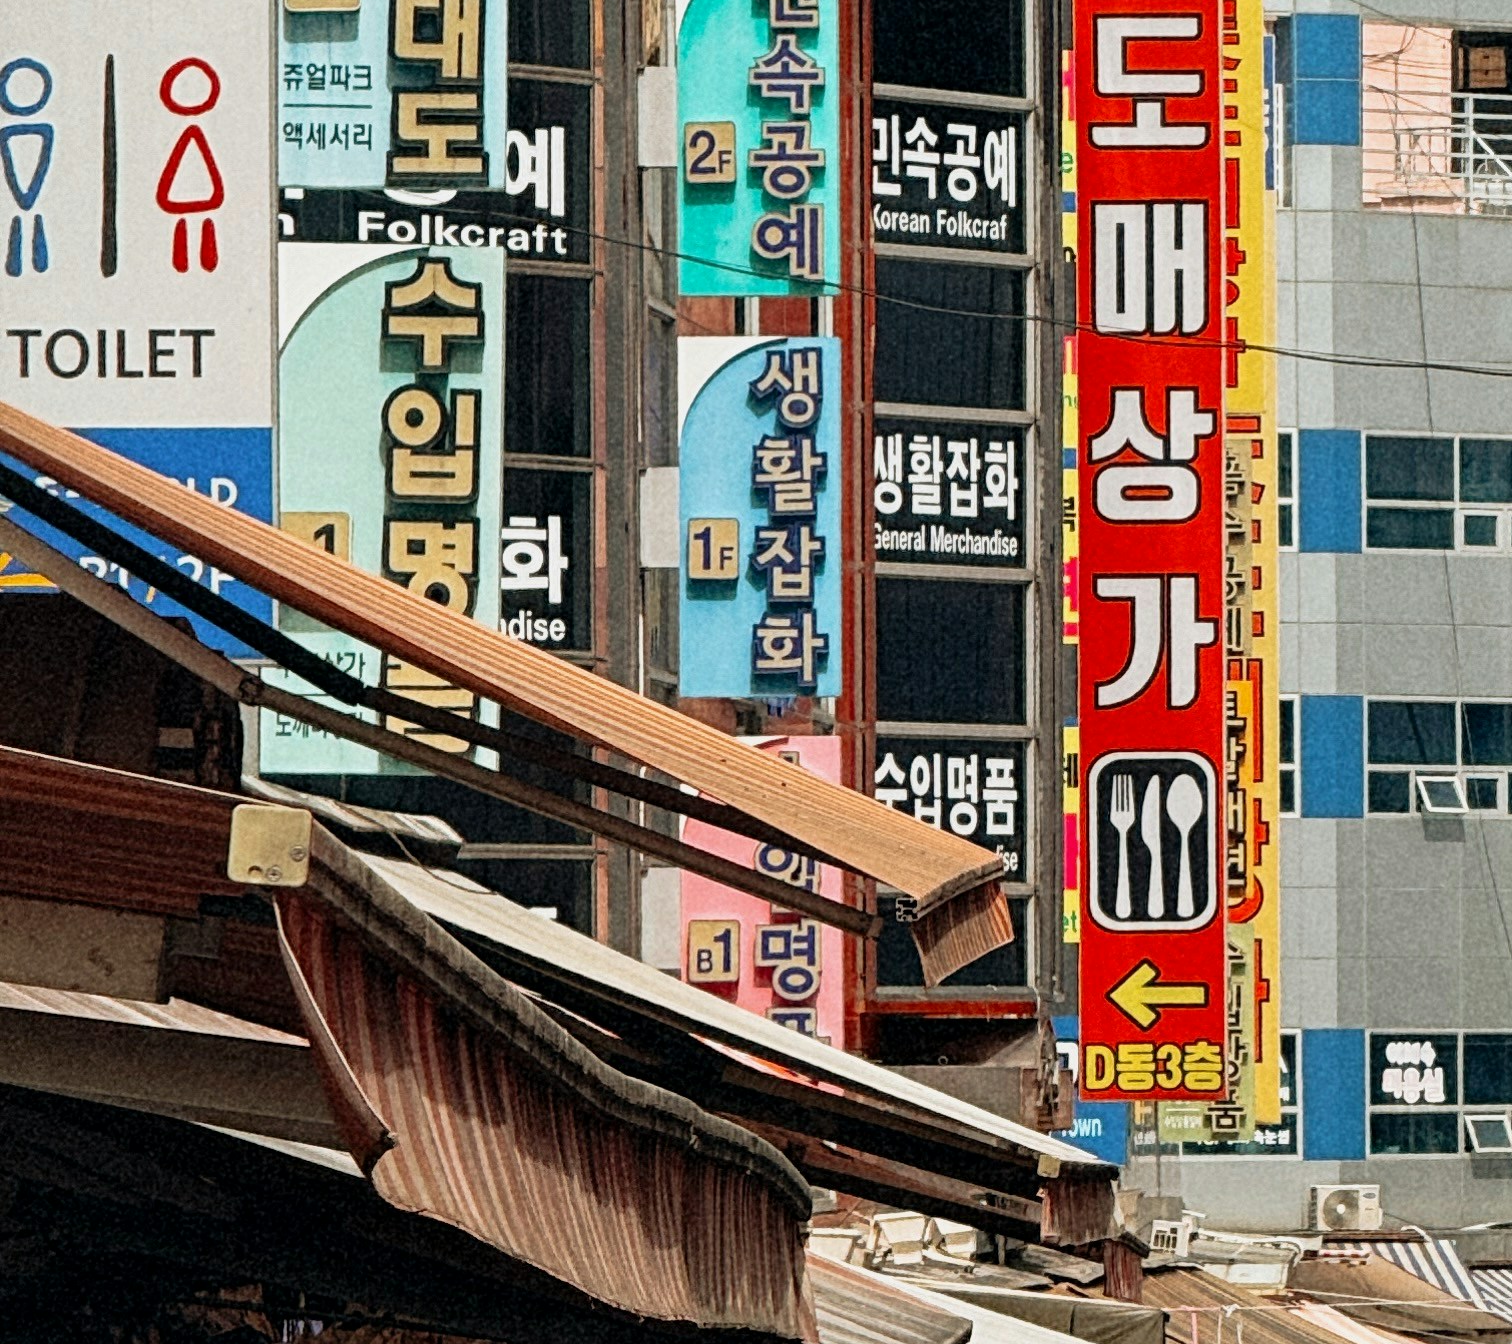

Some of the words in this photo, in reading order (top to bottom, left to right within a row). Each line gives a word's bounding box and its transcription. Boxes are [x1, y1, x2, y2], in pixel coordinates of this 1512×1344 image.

[282, 63, 373, 91] 쥬얼파크
[282, 122, 373, 151] 액세서리
[687, 129, 732, 175] 2F
[872, 114, 1017, 210] 민속공예
[357, 211, 568, 255] Folkcraft
[6, 329, 215, 379] TOILET
[873, 433, 1018, 521] 생활잡화
[752, 346, 828, 687] 생활잡화
[691, 526, 734, 571] 1F
[930, 526, 1018, 567] Merchandise
[696, 926, 732, 972] B1
[1084, 1040, 1225, 1093] D동3층
